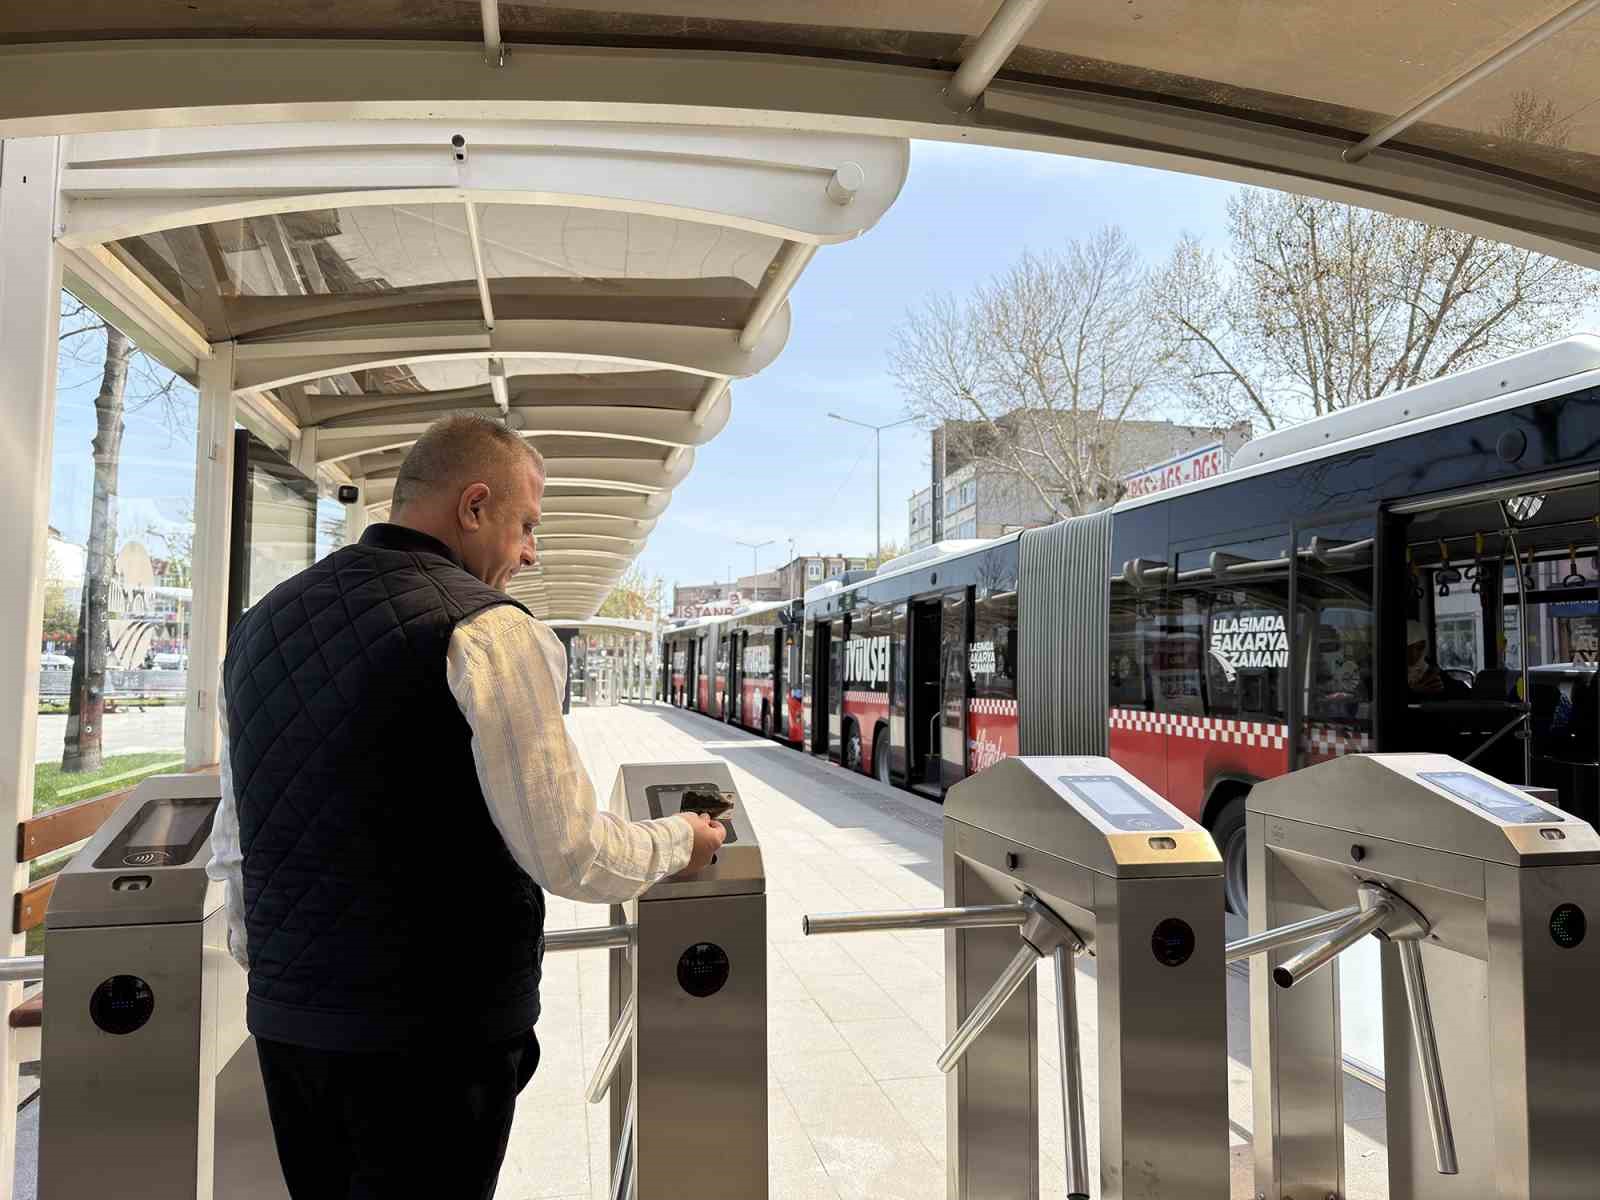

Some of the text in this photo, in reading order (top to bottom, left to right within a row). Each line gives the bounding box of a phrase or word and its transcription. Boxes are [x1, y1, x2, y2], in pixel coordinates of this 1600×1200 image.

[1193, 452, 1217, 481] DGS
[1213, 615, 1285, 634] ULAŞIMDA
[1210, 632, 1289, 651] SAKARYA
[1230, 651, 1289, 668] ZAMANI
